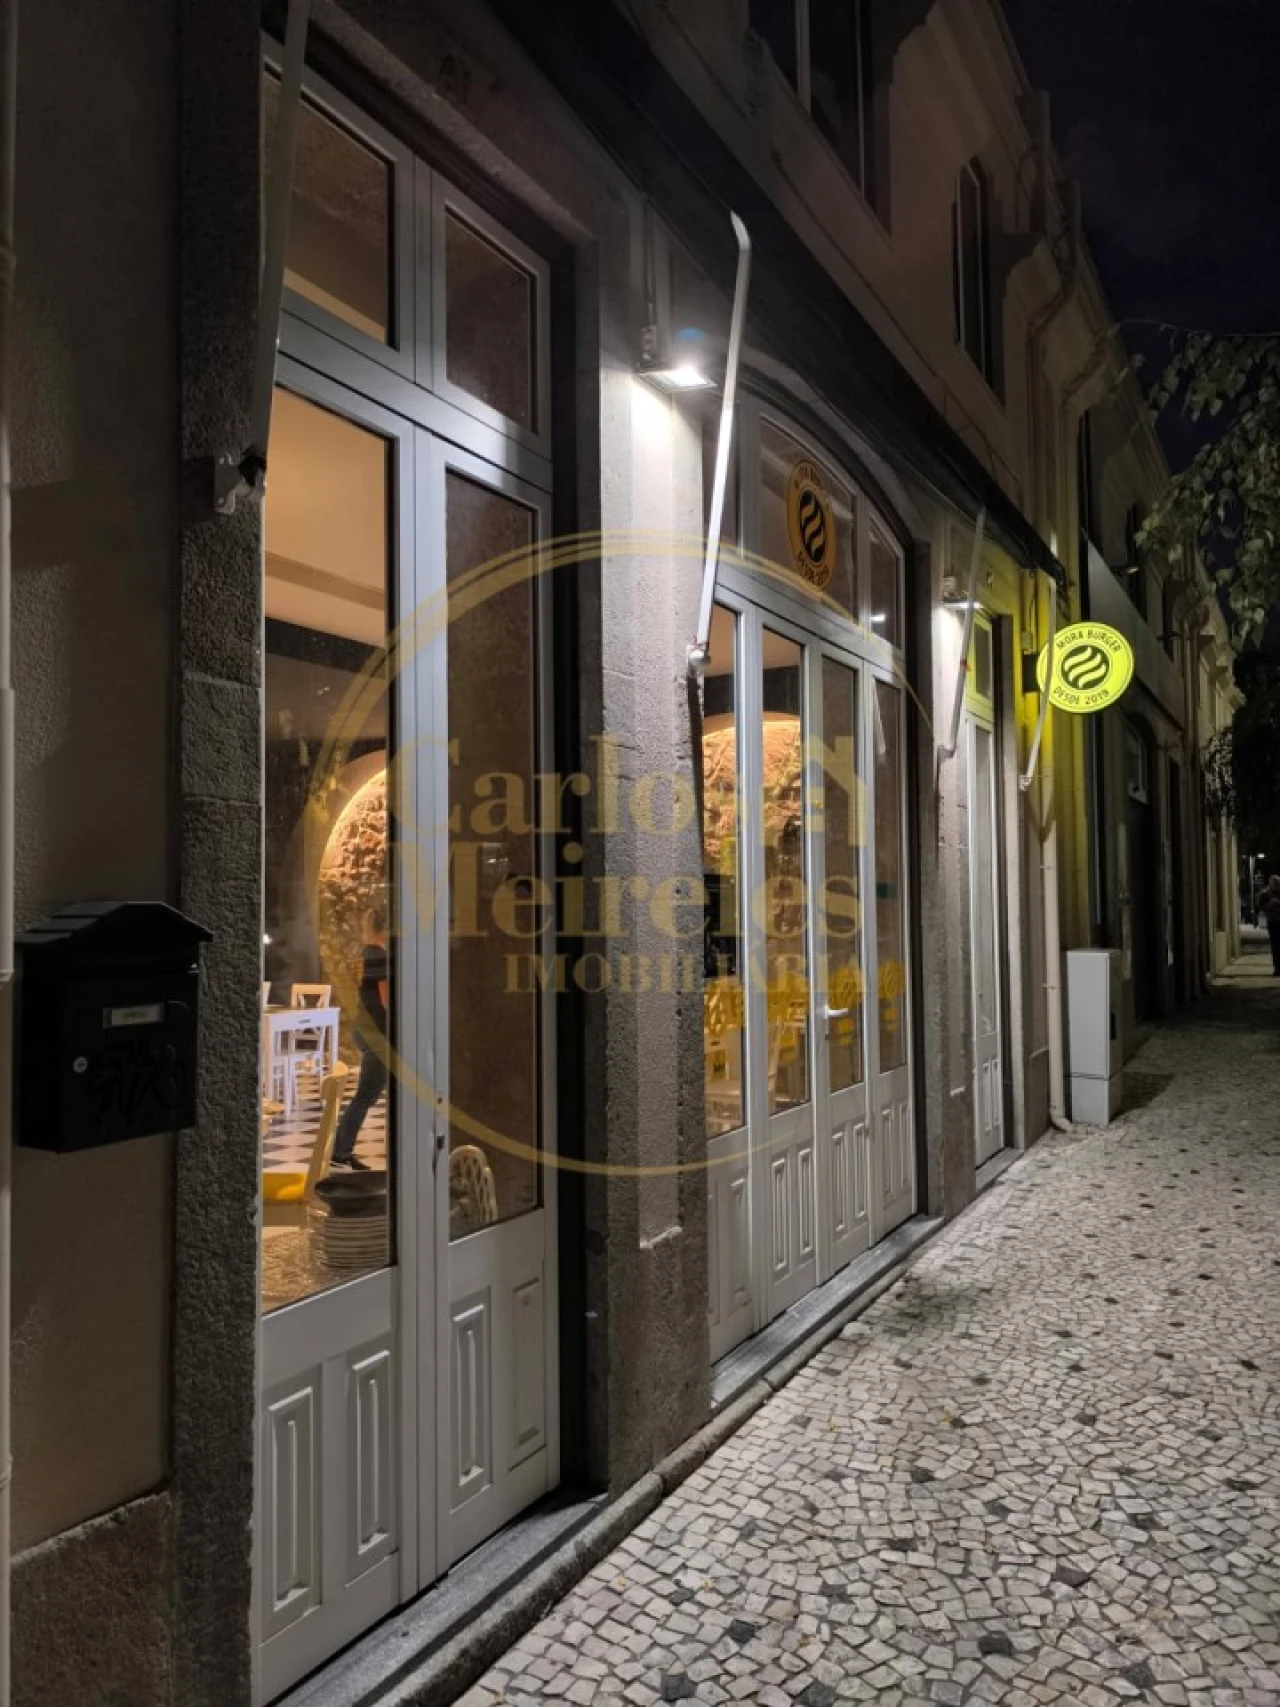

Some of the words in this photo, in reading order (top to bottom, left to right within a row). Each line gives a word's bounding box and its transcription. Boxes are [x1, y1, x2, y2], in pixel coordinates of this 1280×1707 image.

[1055, 630, 1084, 650] MORA
[1087, 628, 1122, 653] BURGER
[1053, 686, 1081, 705] DESDE
